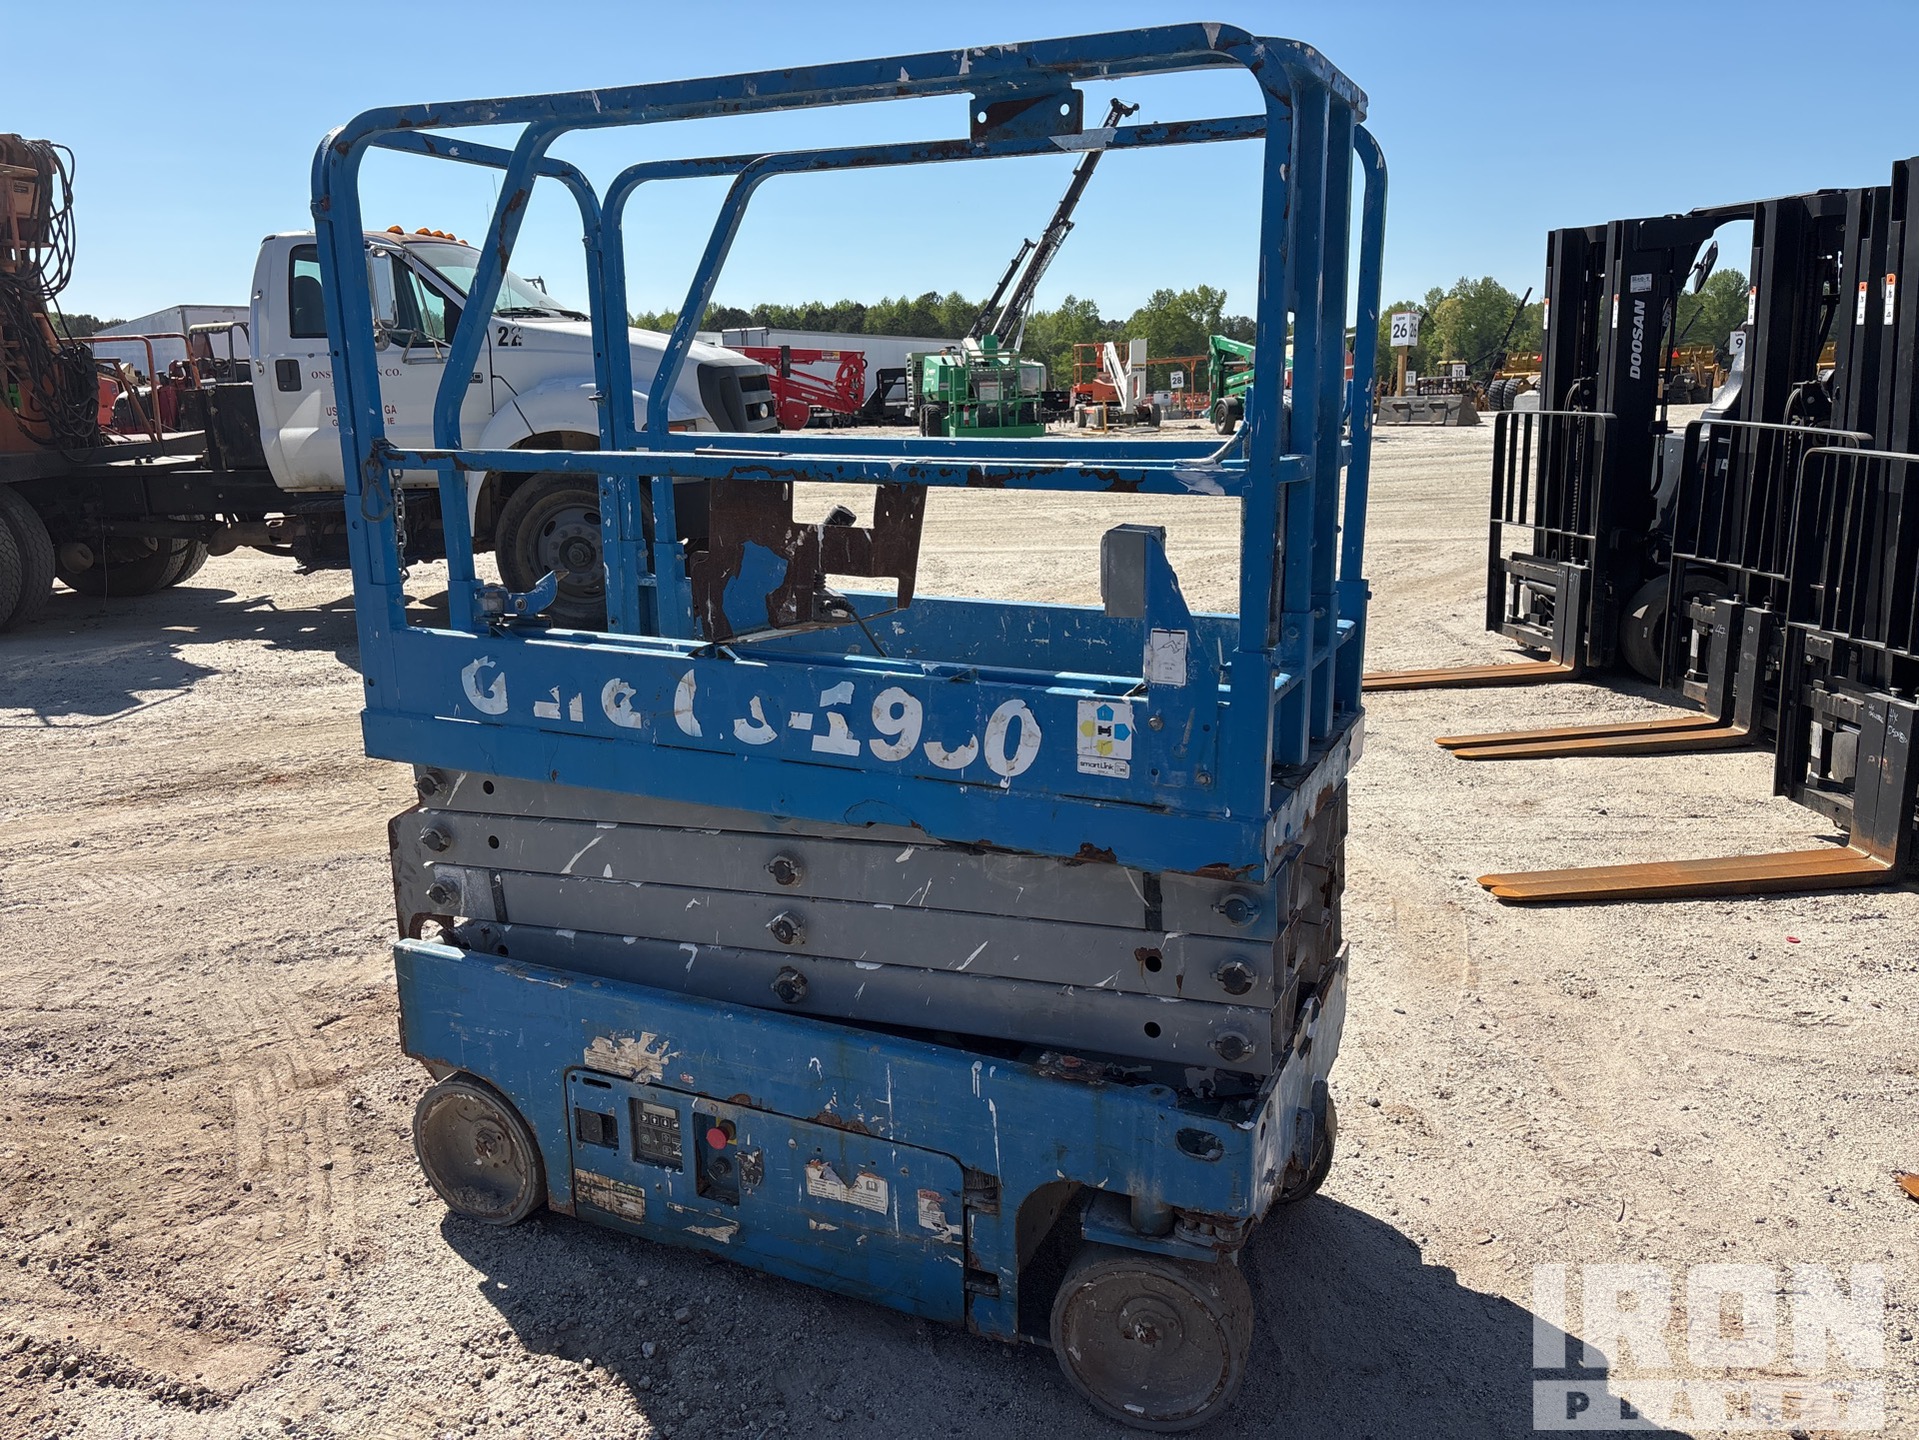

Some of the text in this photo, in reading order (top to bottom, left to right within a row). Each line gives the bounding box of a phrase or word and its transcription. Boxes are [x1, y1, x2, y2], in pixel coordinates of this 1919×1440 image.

[1393, 323, 1407, 338] 26
[1630, 299, 1646, 380] DOOSAN
[1735, 338, 1744, 348] 9
[1172, 376, 1182, 385] 28
